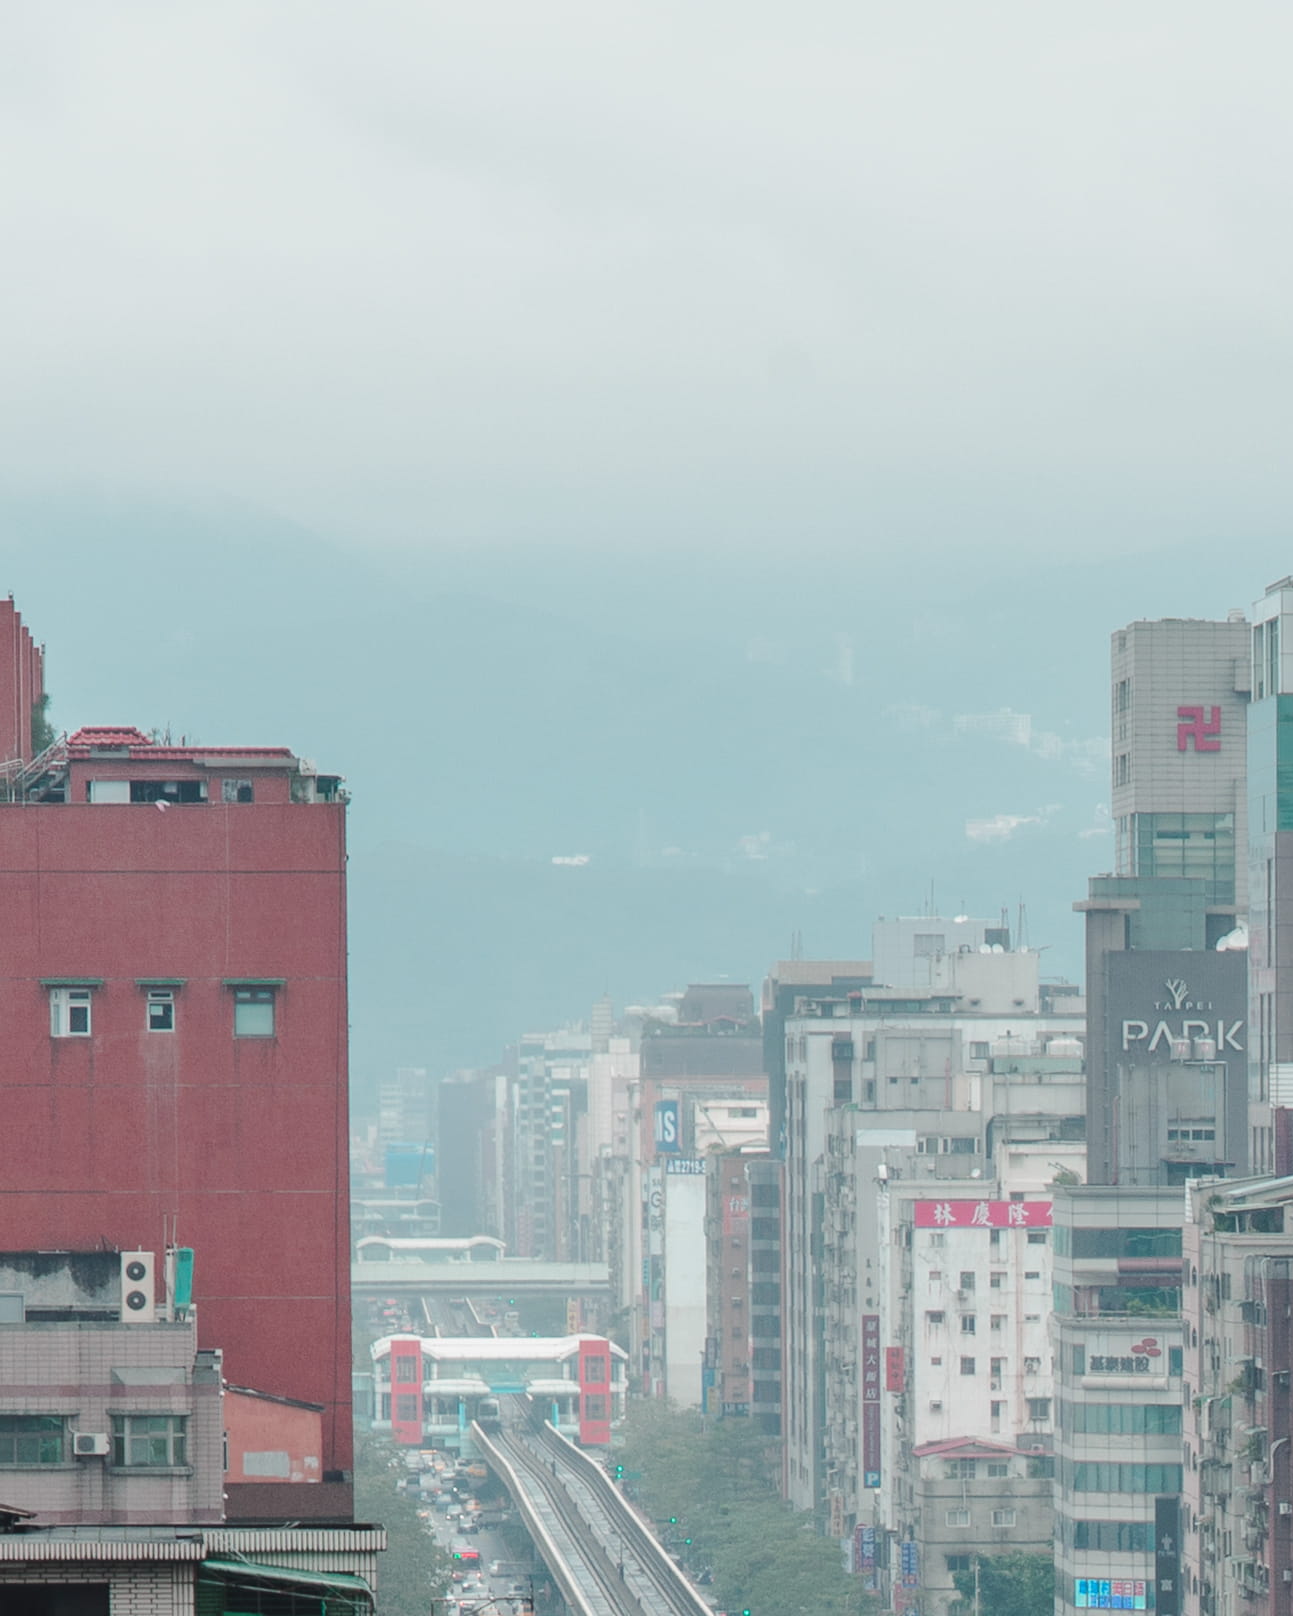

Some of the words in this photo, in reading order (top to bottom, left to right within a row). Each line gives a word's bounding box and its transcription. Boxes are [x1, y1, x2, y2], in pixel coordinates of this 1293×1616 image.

[1122, 1019, 1244, 1051] PARK
[933, 1201, 1052, 1227] 林慶隆
